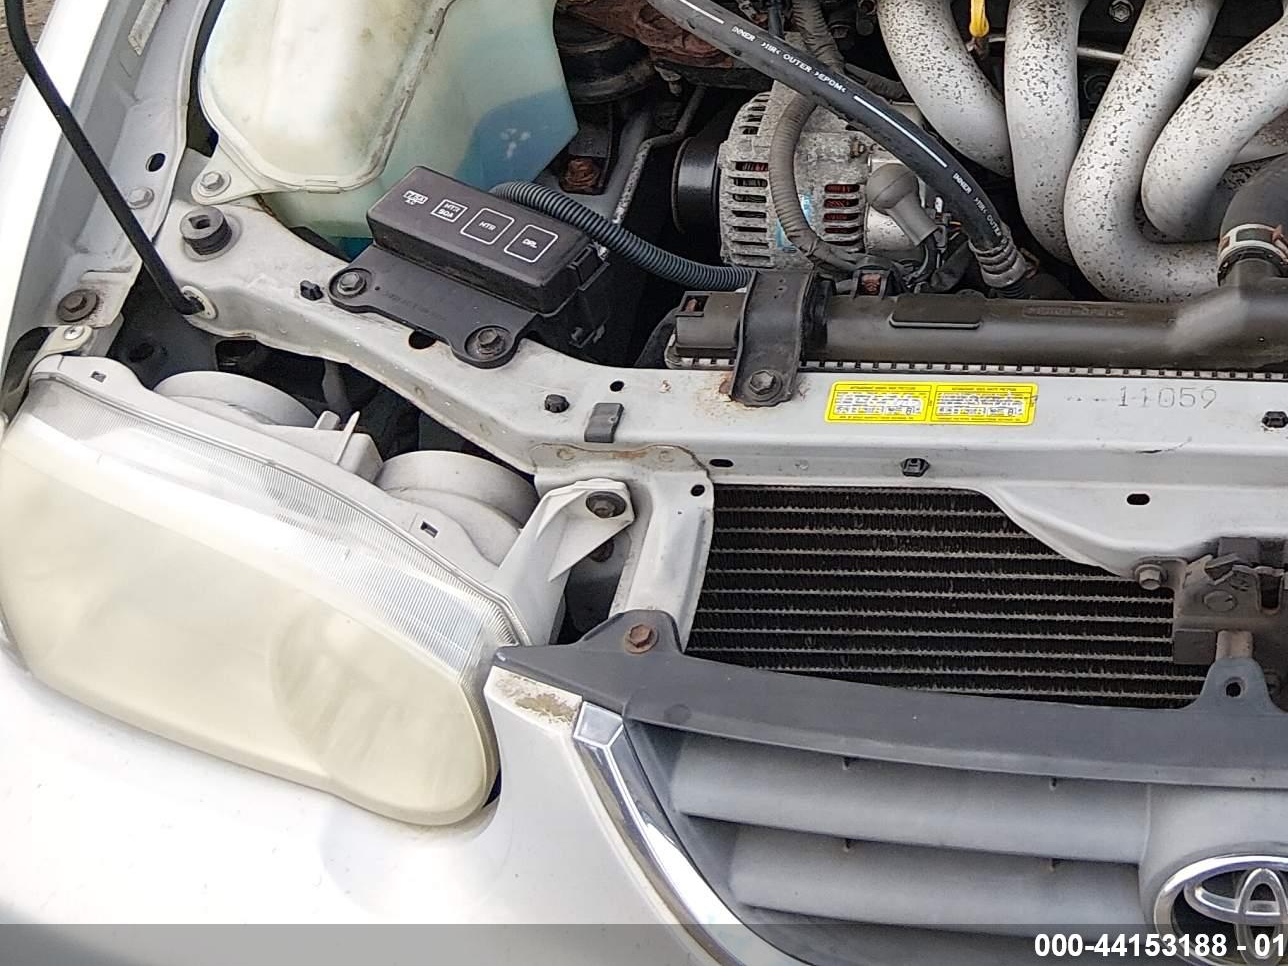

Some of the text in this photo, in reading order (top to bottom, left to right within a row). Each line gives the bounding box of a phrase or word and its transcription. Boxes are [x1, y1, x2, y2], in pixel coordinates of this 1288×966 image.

[731, 25, 756, 42] INNER
[783, 53, 813, 74] OUTER
[479, 220, 497, 232] MTR
[1118, 385, 1218, 409] 11059
